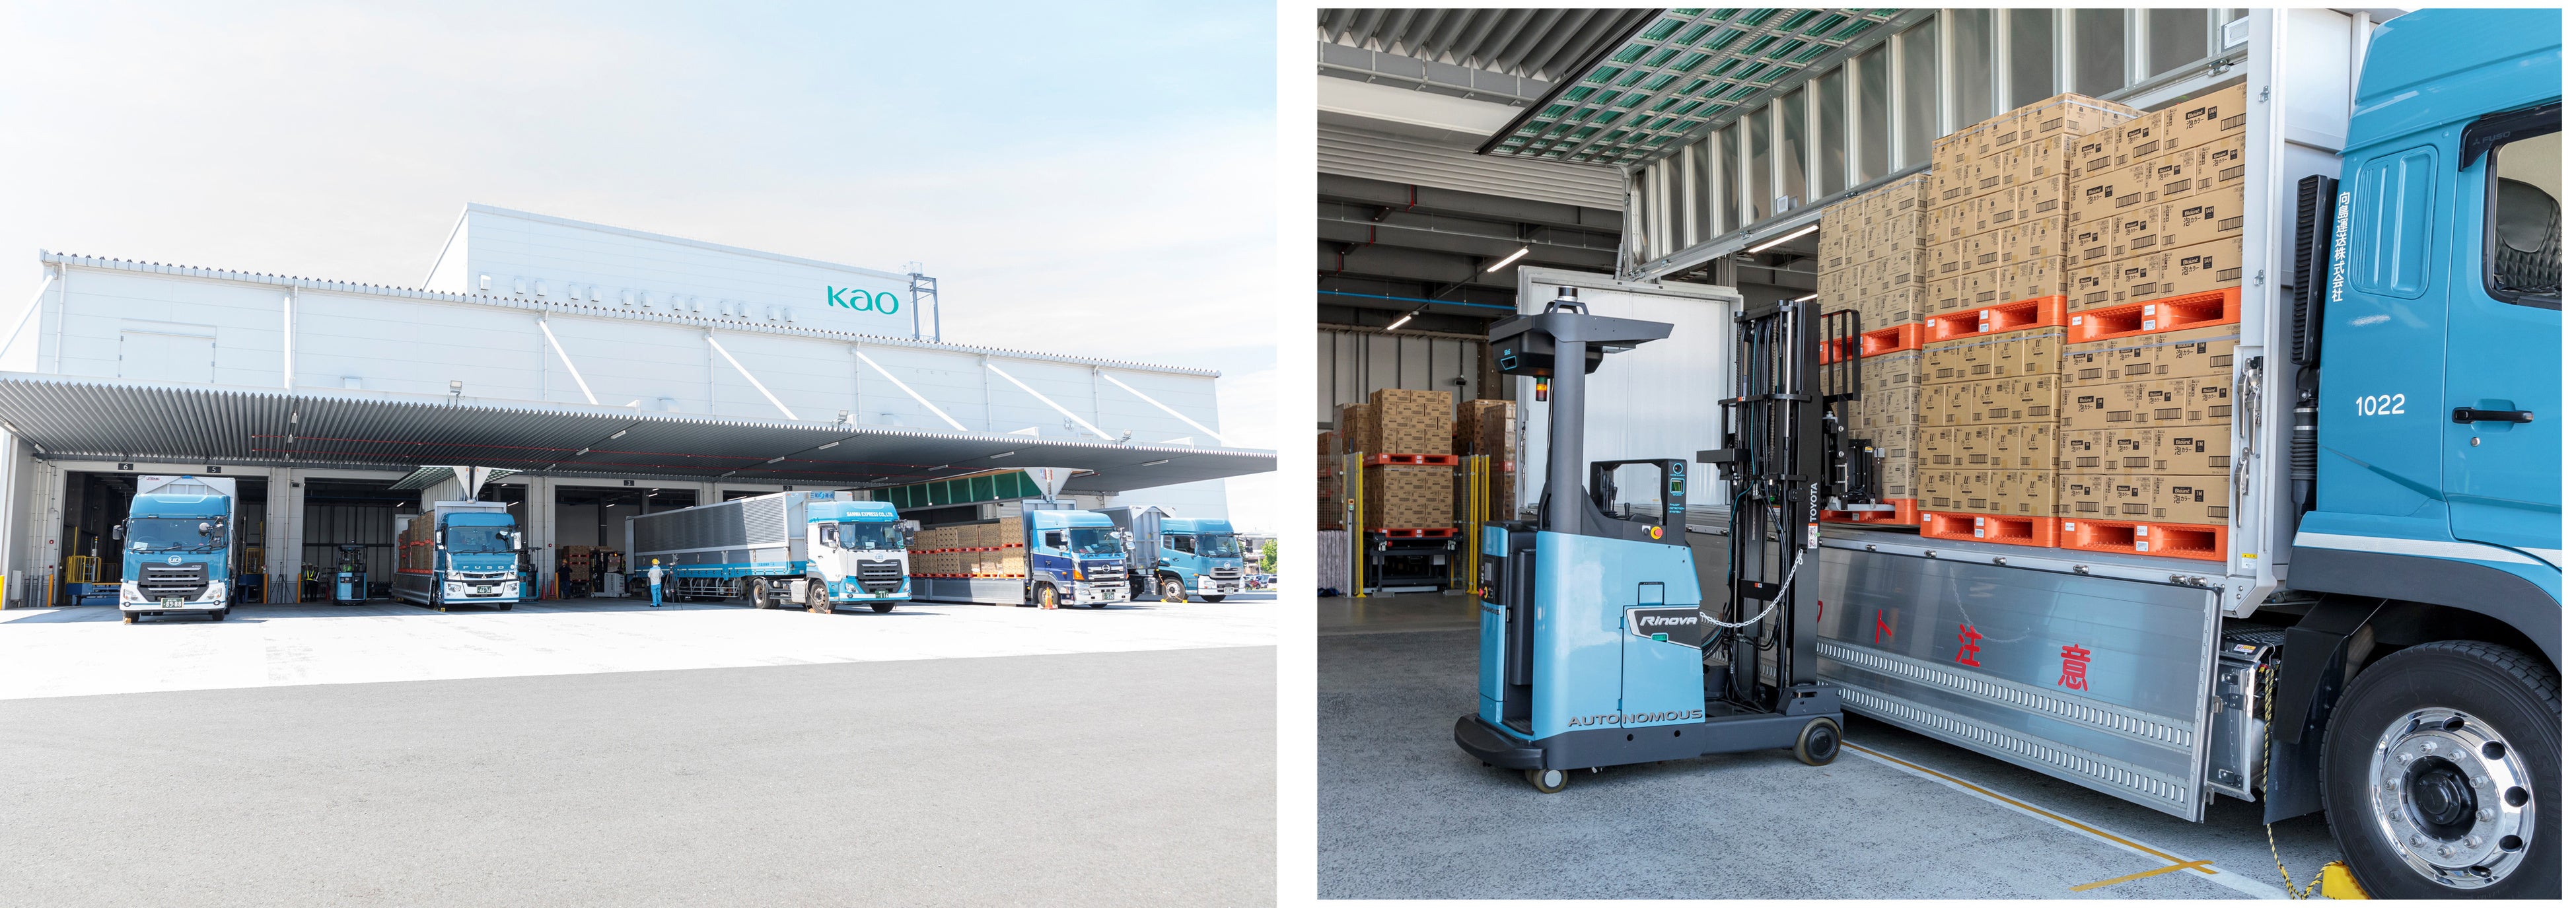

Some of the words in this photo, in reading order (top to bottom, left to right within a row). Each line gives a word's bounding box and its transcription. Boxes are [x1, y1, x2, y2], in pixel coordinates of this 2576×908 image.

[2186, 118, 2203, 129] 泡カラー
[2482, 131, 2511, 143] FUSO
[2087, 195, 2102, 205] 泡カラー
[2184, 216, 2201, 227] 泡カラー
[2332, 192, 2350, 302] 向島運送株式会社
[2182, 265, 2199, 275] 泡カラー
[2176, 349, 2194, 359] 泡カラー
[2079, 403, 2093, 412] 泡カラー
[2355, 394, 2406, 416] 1022
[2174, 446, 2192, 455] 泡カラー
[2173, 495, 2191, 504] 泡カラー
[1639, 616, 1698, 626] Rinova
[1568, 709, 1703, 726] AUTONOMOUS
